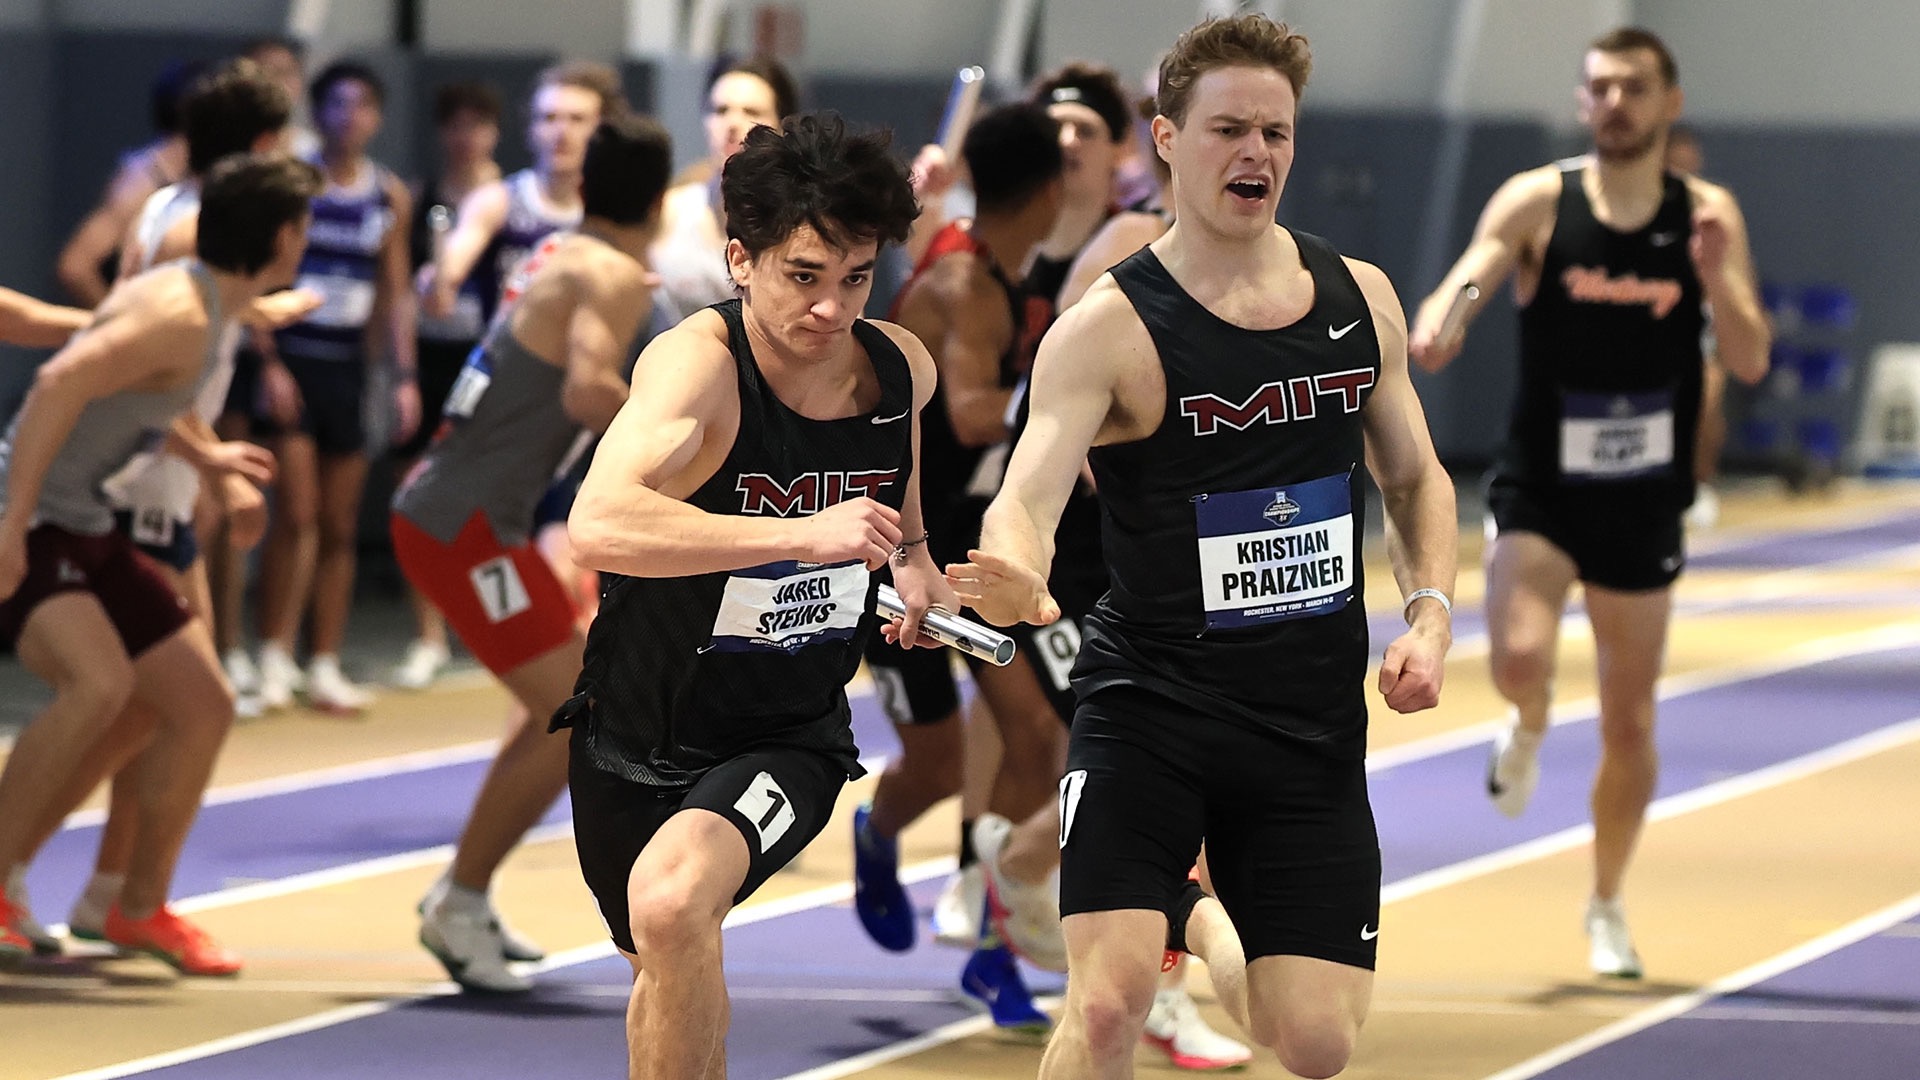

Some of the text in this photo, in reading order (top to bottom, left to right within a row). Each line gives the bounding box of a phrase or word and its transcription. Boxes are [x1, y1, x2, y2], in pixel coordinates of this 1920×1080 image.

[1180, 367, 1375, 436] MIT
[735, 467, 899, 518] MIT
[1236, 529, 1329, 565] KRISTIAN
[482, 564, 509, 611] 7
[772, 576, 831, 605] JARED
[1221, 555, 1344, 601] PRAIZNER
[755, 603, 837, 635] STEINS
[1275, 604, 1288, 612] NEW
[1288, 602, 1302, 611] YORK
[1305, 599, 1323, 608] MARCH
[757, 788, 787, 833] 1
